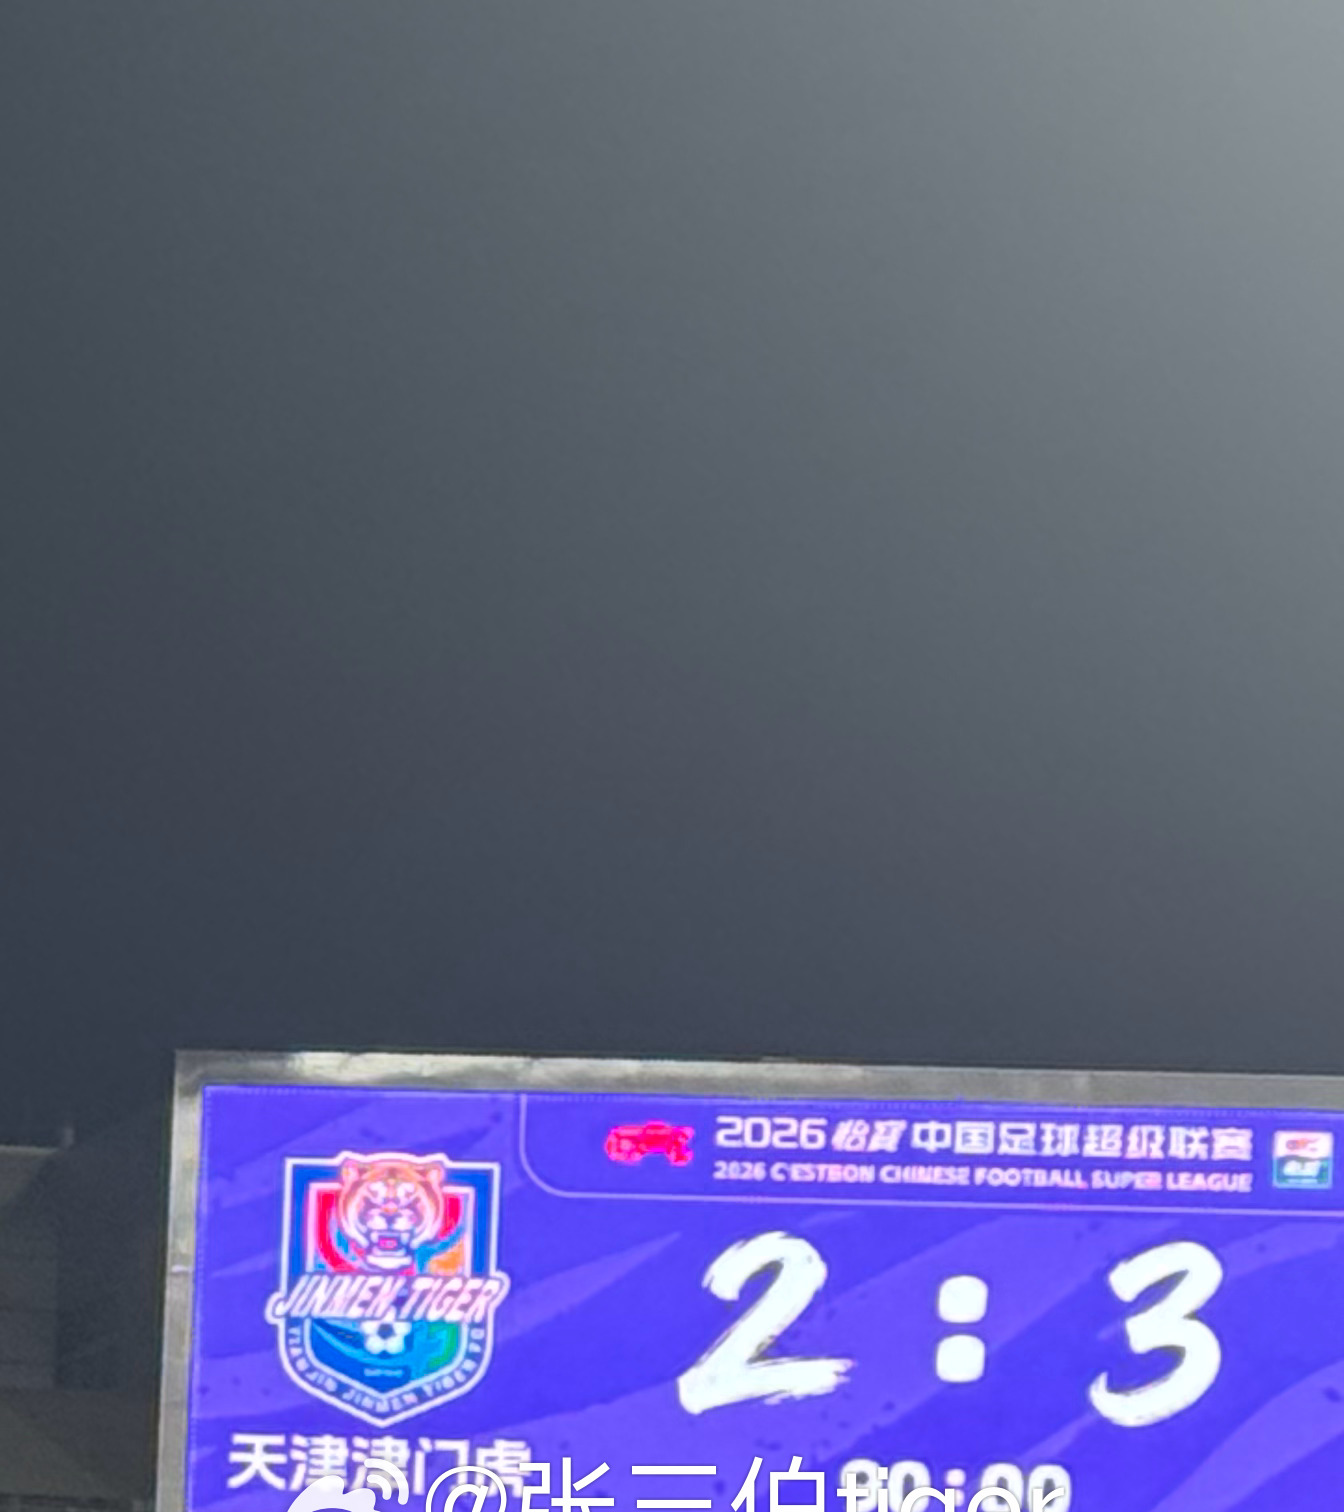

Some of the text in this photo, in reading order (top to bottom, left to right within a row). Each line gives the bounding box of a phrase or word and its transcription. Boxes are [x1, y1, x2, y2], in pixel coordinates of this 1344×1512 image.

[712, 1160, 766, 1181] 2026
[879, 1164, 971, 1186] CHINESE
[974, 1167, 1088, 1189] FOOTBALL
[1092, 1170, 1163, 1191] SUPER
[1166, 1171, 1253, 1193] LEAGUE
[273, 1273, 501, 1323] JINMEN TIGER
[677, 1230, 857, 1415] 2
[1089, 1241, 1224, 1427] 3
